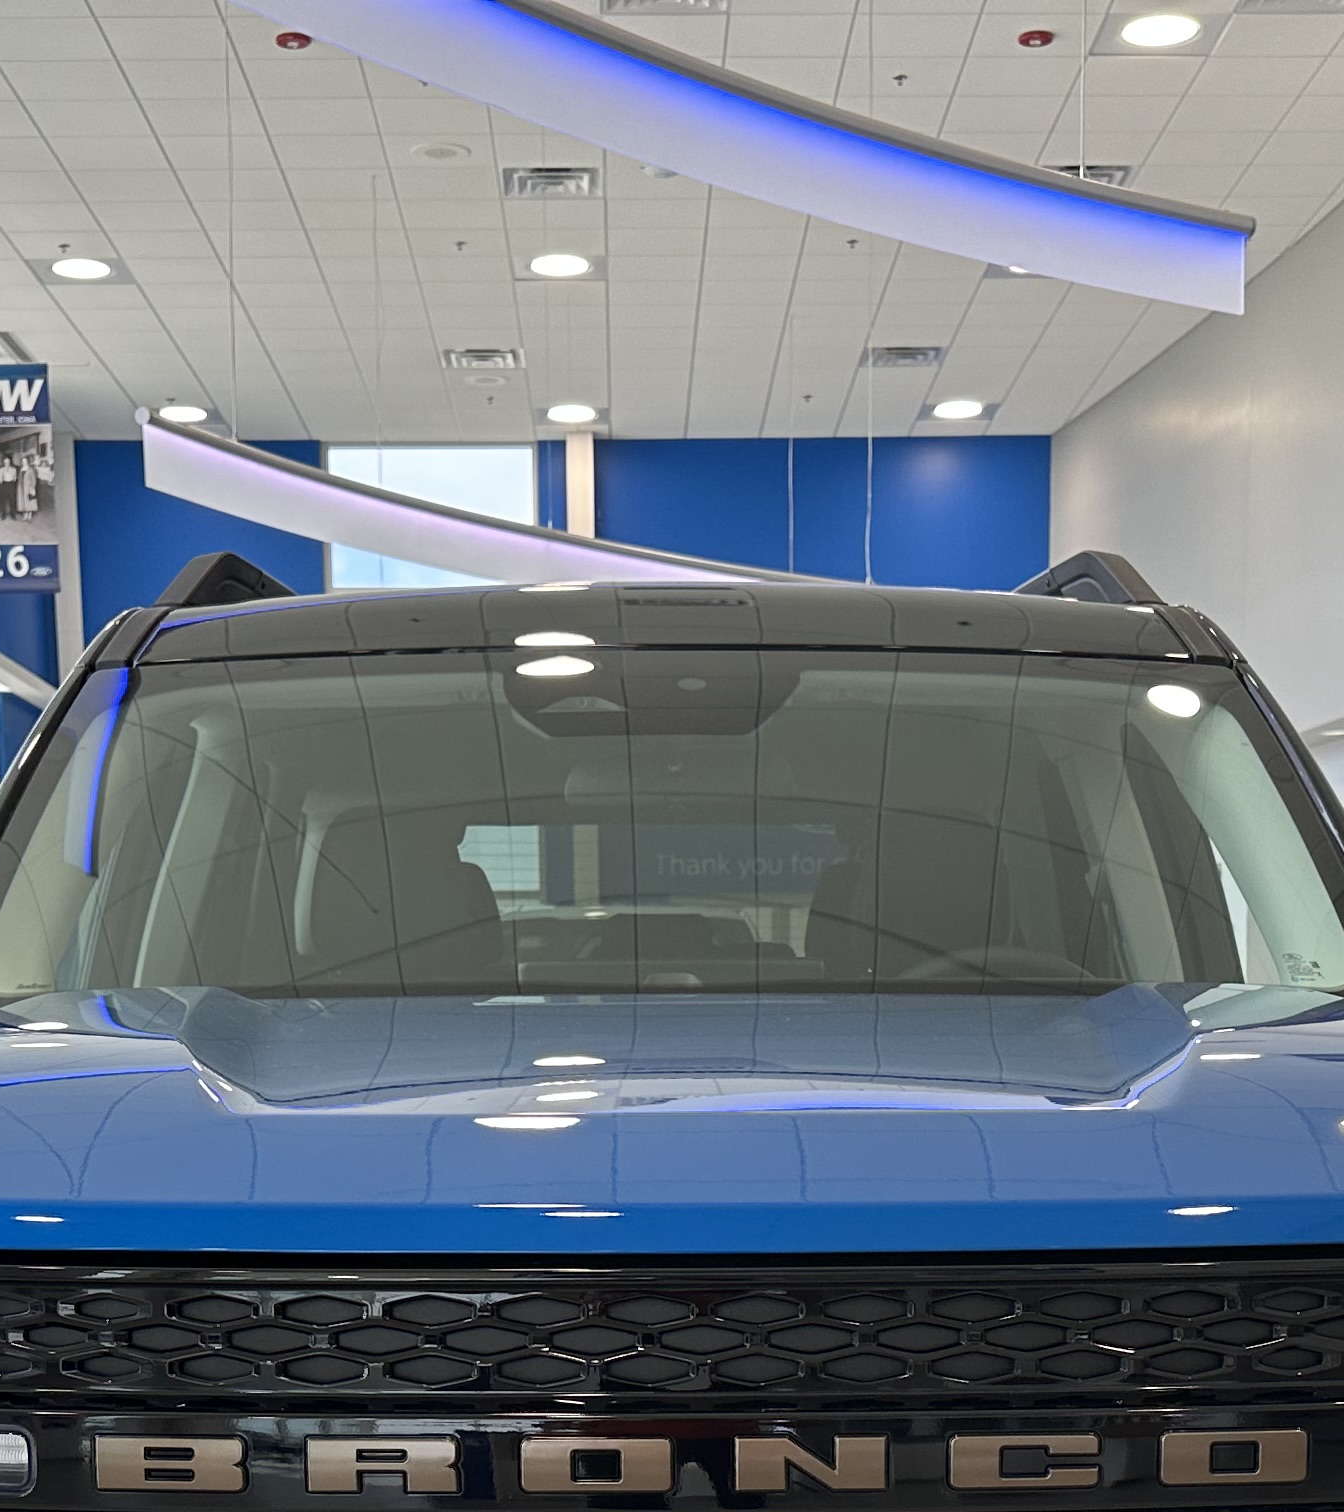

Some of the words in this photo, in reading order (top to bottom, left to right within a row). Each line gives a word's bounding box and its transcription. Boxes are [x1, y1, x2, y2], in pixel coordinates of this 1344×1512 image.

[656, 853, 731, 876] Thank
[739, 858, 783, 880] you
[791, 854, 825, 876] for
[94, 1429, 1308, 1493] BRONCO
